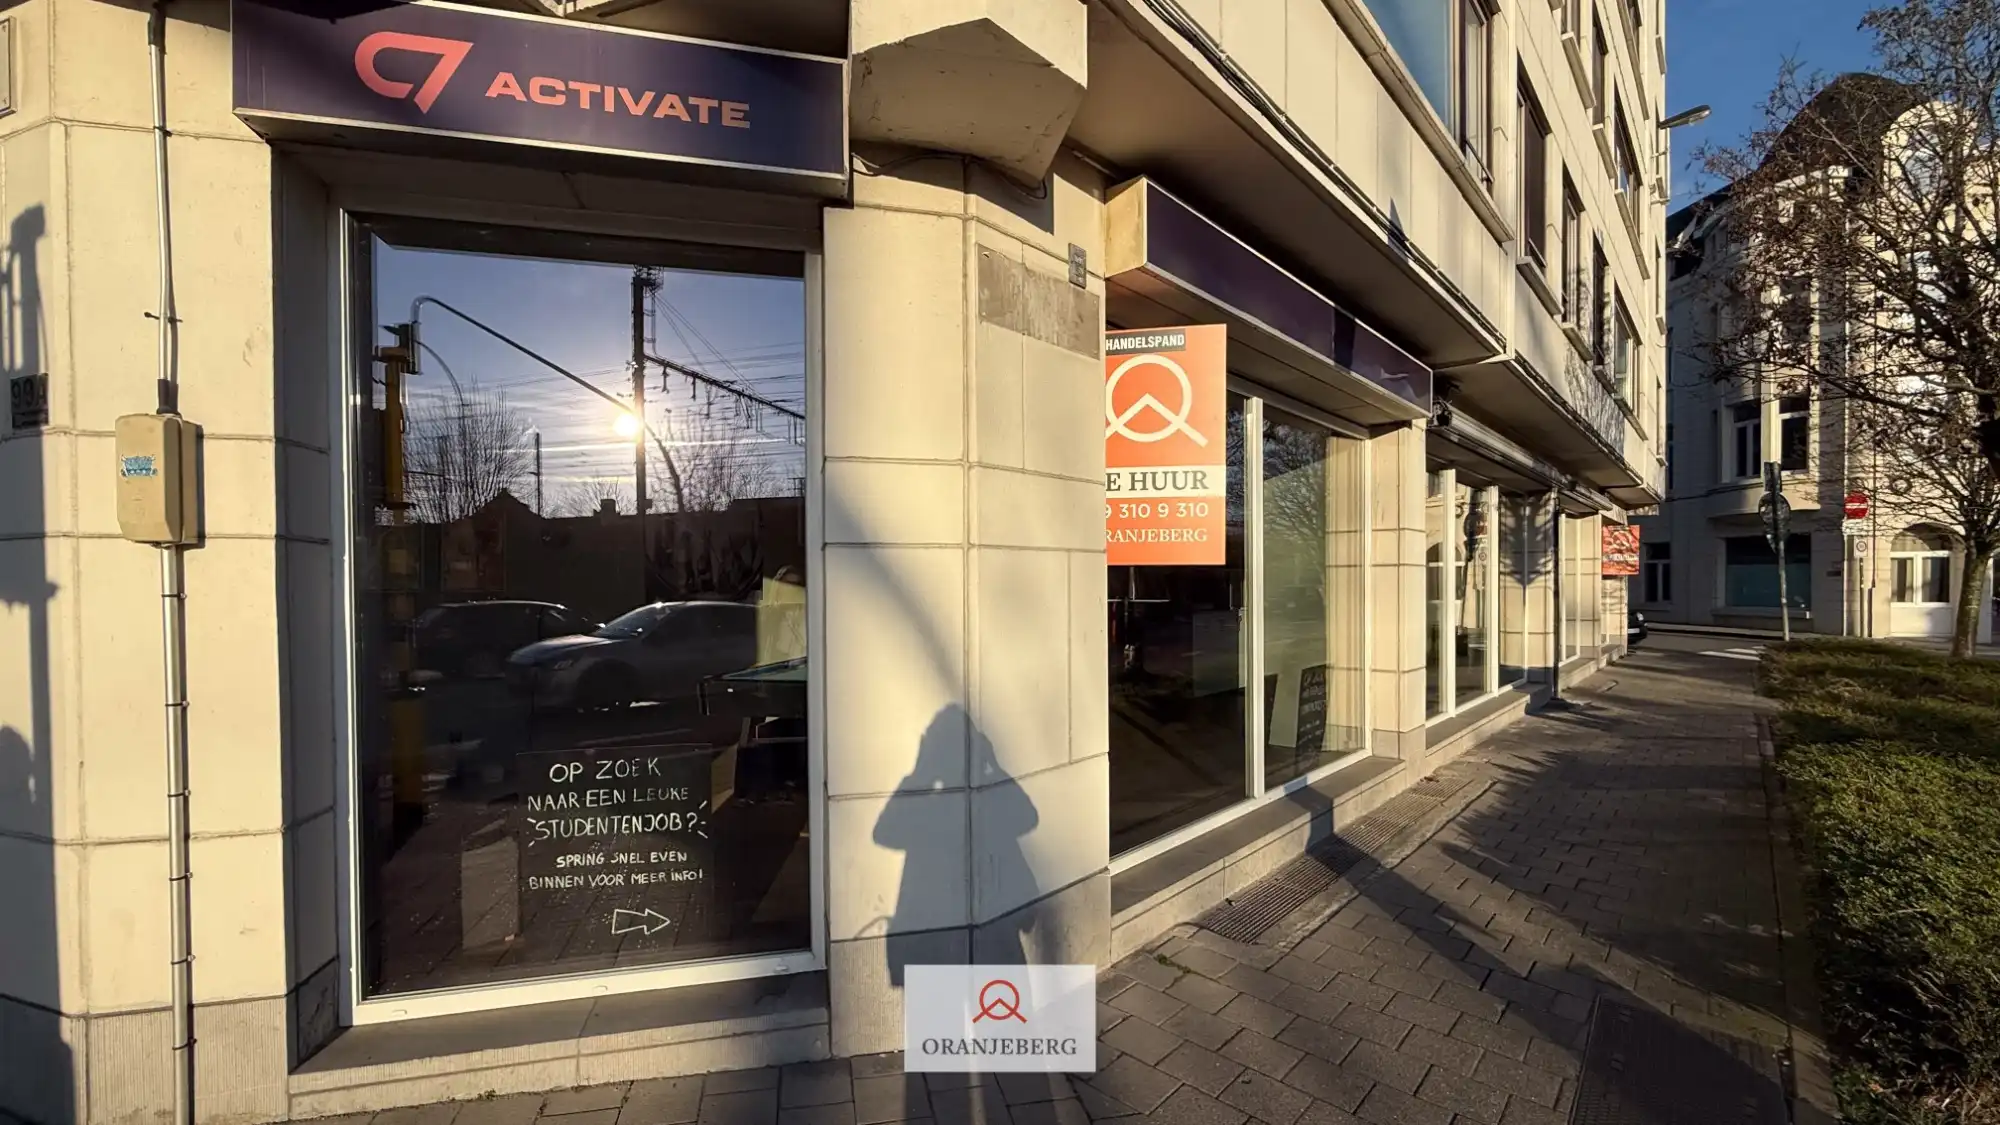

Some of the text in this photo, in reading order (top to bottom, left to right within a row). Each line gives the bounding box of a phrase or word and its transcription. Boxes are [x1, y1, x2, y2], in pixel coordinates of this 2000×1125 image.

[485, 71, 751, 129] ACTIVATE
[1105, 334, 1185, 350] HANDELSPAND
[1105, 470, 1210, 491] E HUUR
[1119, 503, 1151, 518] 310
[1157, 502, 1169, 517] 9
[1175, 502, 1208, 517] 310
[1105, 528, 1208, 542] RANJEBERG
[549, 757, 662, 783] OP ZOEK
[527, 787, 689, 812] NAAR EEN LEUKE
[534, 812, 698, 840] STUDENTENJOB?
[556, 851, 687, 868] SPRING SNEL EVEN
[528, 868, 703, 889] BINNEN VOOR MEER INFO!
